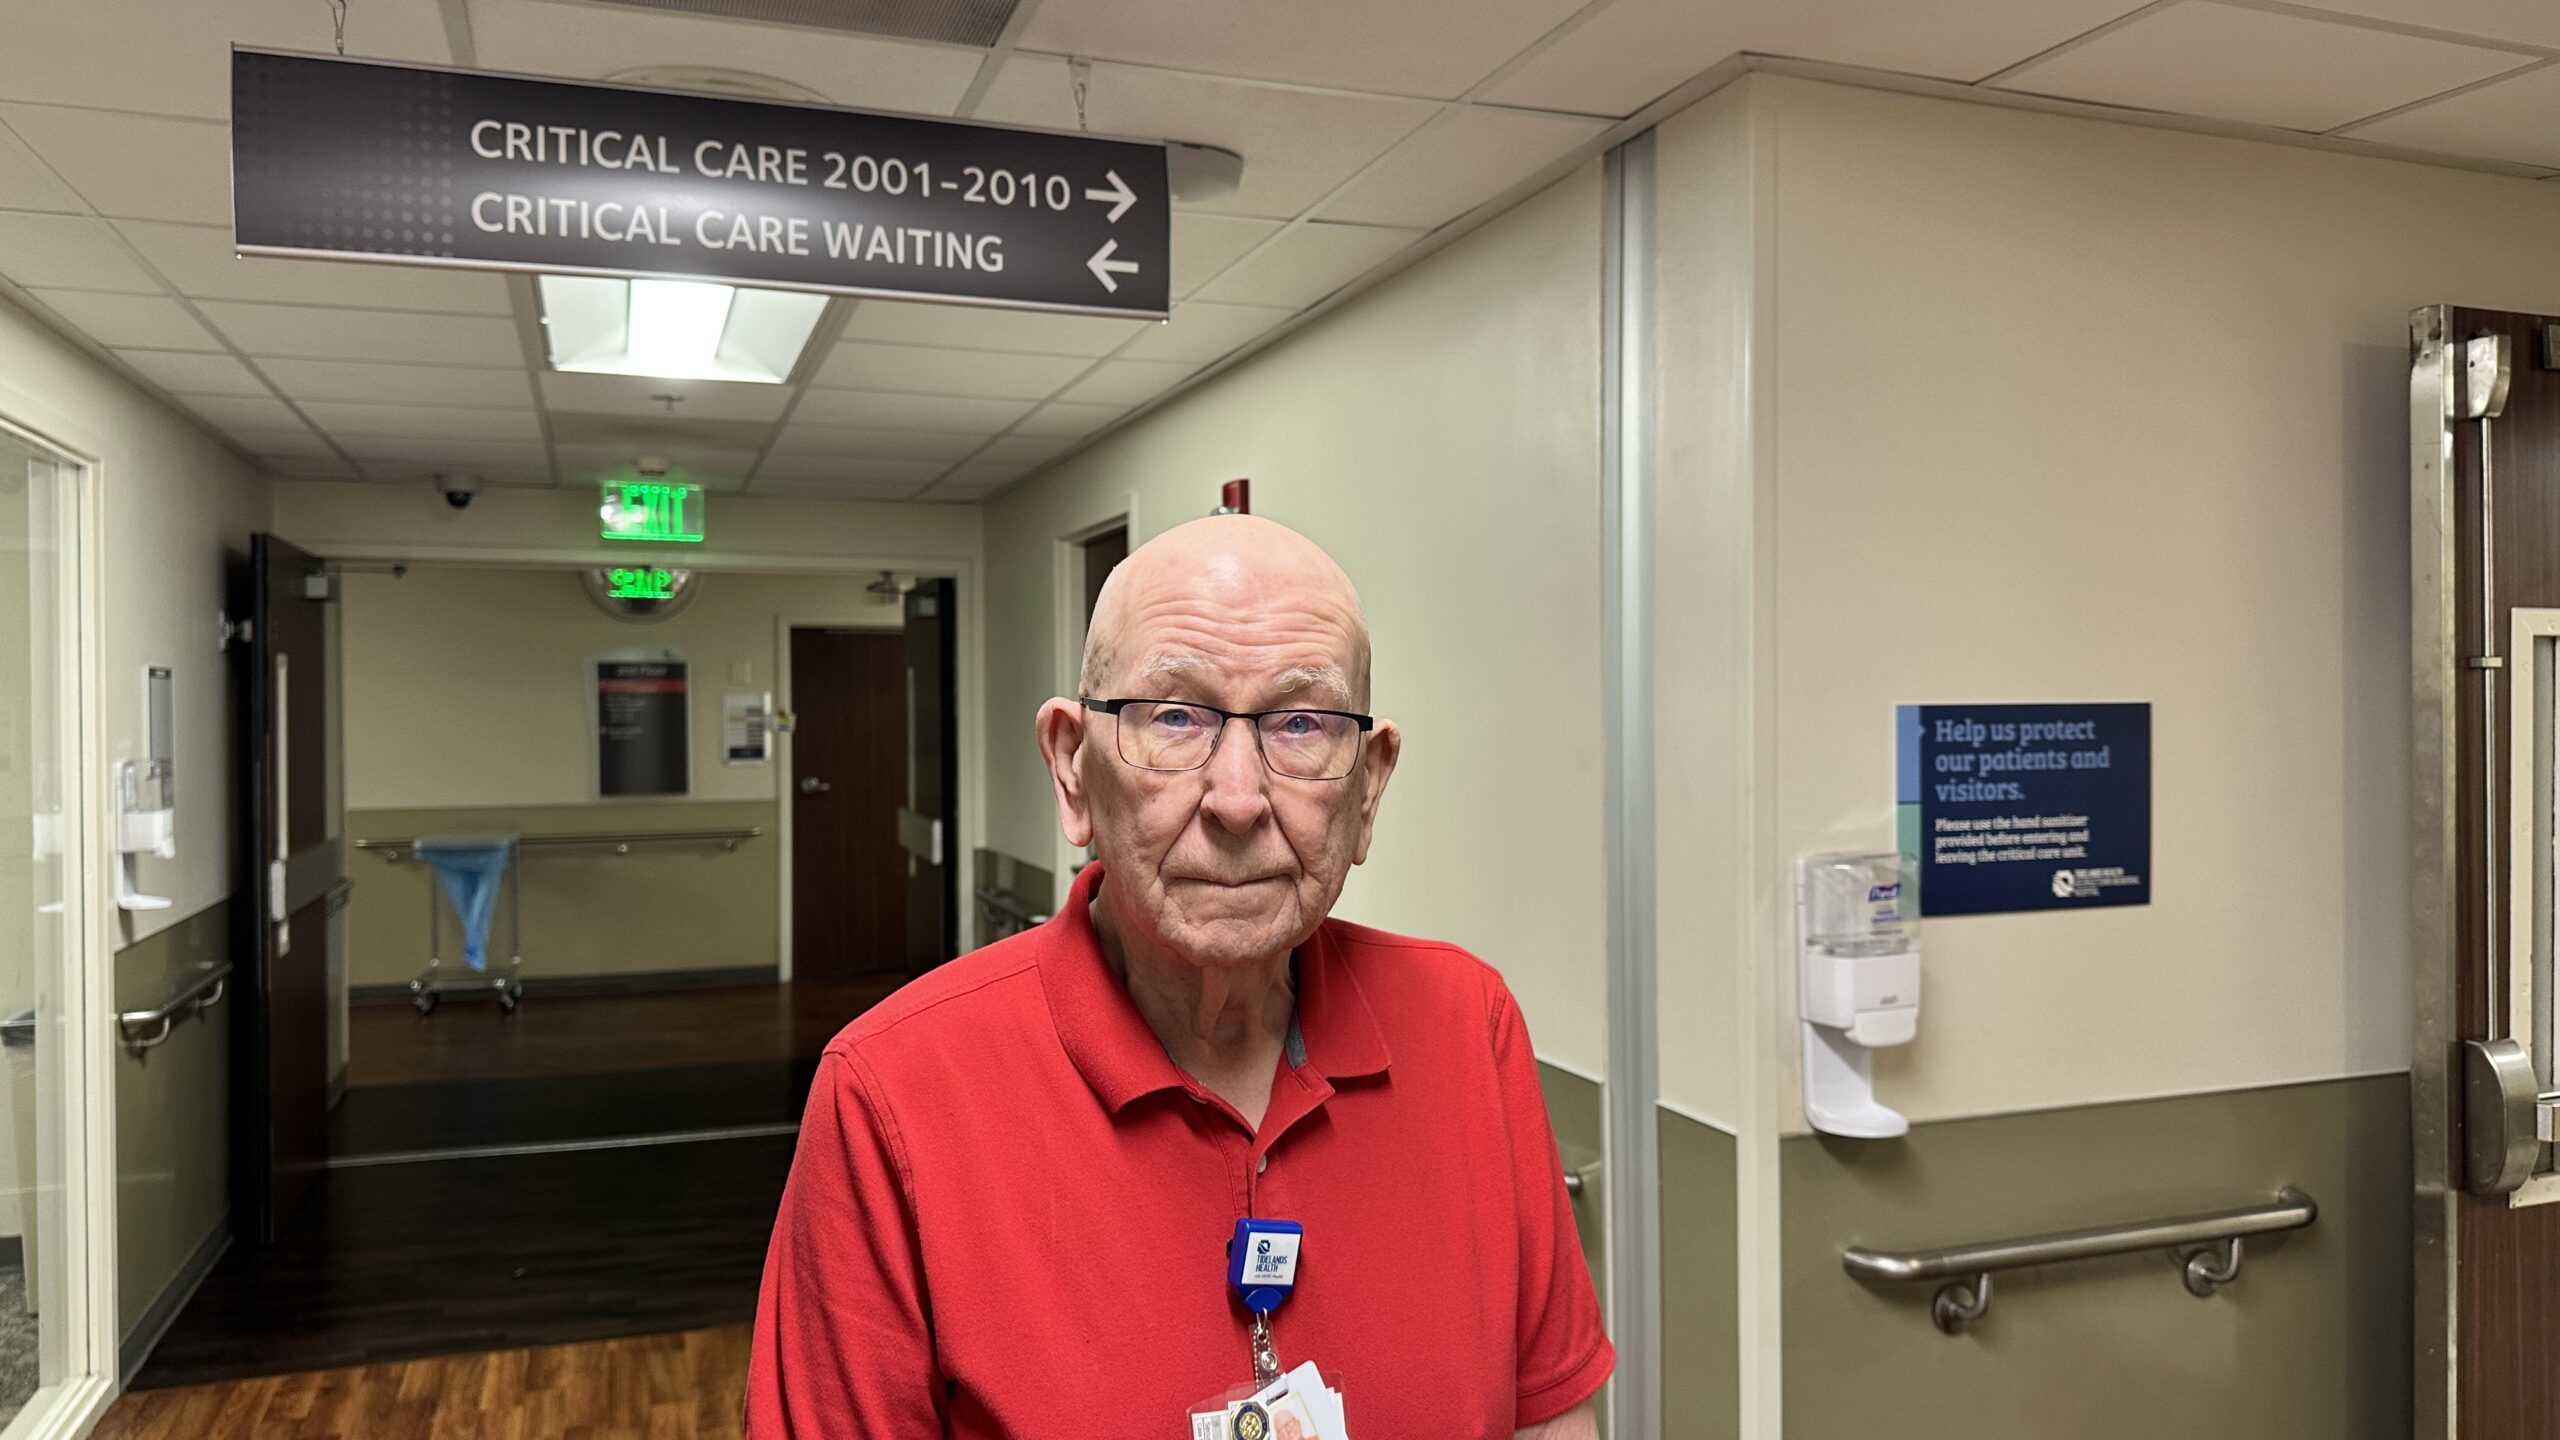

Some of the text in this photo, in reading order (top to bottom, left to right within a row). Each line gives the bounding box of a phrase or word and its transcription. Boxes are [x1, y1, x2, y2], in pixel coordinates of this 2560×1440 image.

[470, 120, 1071, 212] CRITICAL CARE 2001-2010
[470, 191, 1005, 273] CRITICAL CARE WAITING
[622, 484, 688, 535] EXIT
[1934, 717, 2096, 748] Help us protect
[1934, 745, 2111, 778] our patients and
[1934, 777, 2026, 802] visitors.
[1935, 817, 1972, 832] Please
[1972, 819, 1992, 831] use
[1993, 815, 2012, 830] the
[2012, 814, 2041, 829] hand
[1935, 828, 2090, 849] provided before entering and
[1935, 849, 1976, 866] leaving
[1976, 848, 1996, 862] the
[1996, 846, 2036, 861] critical
[2036, 848, 2061, 860] care
